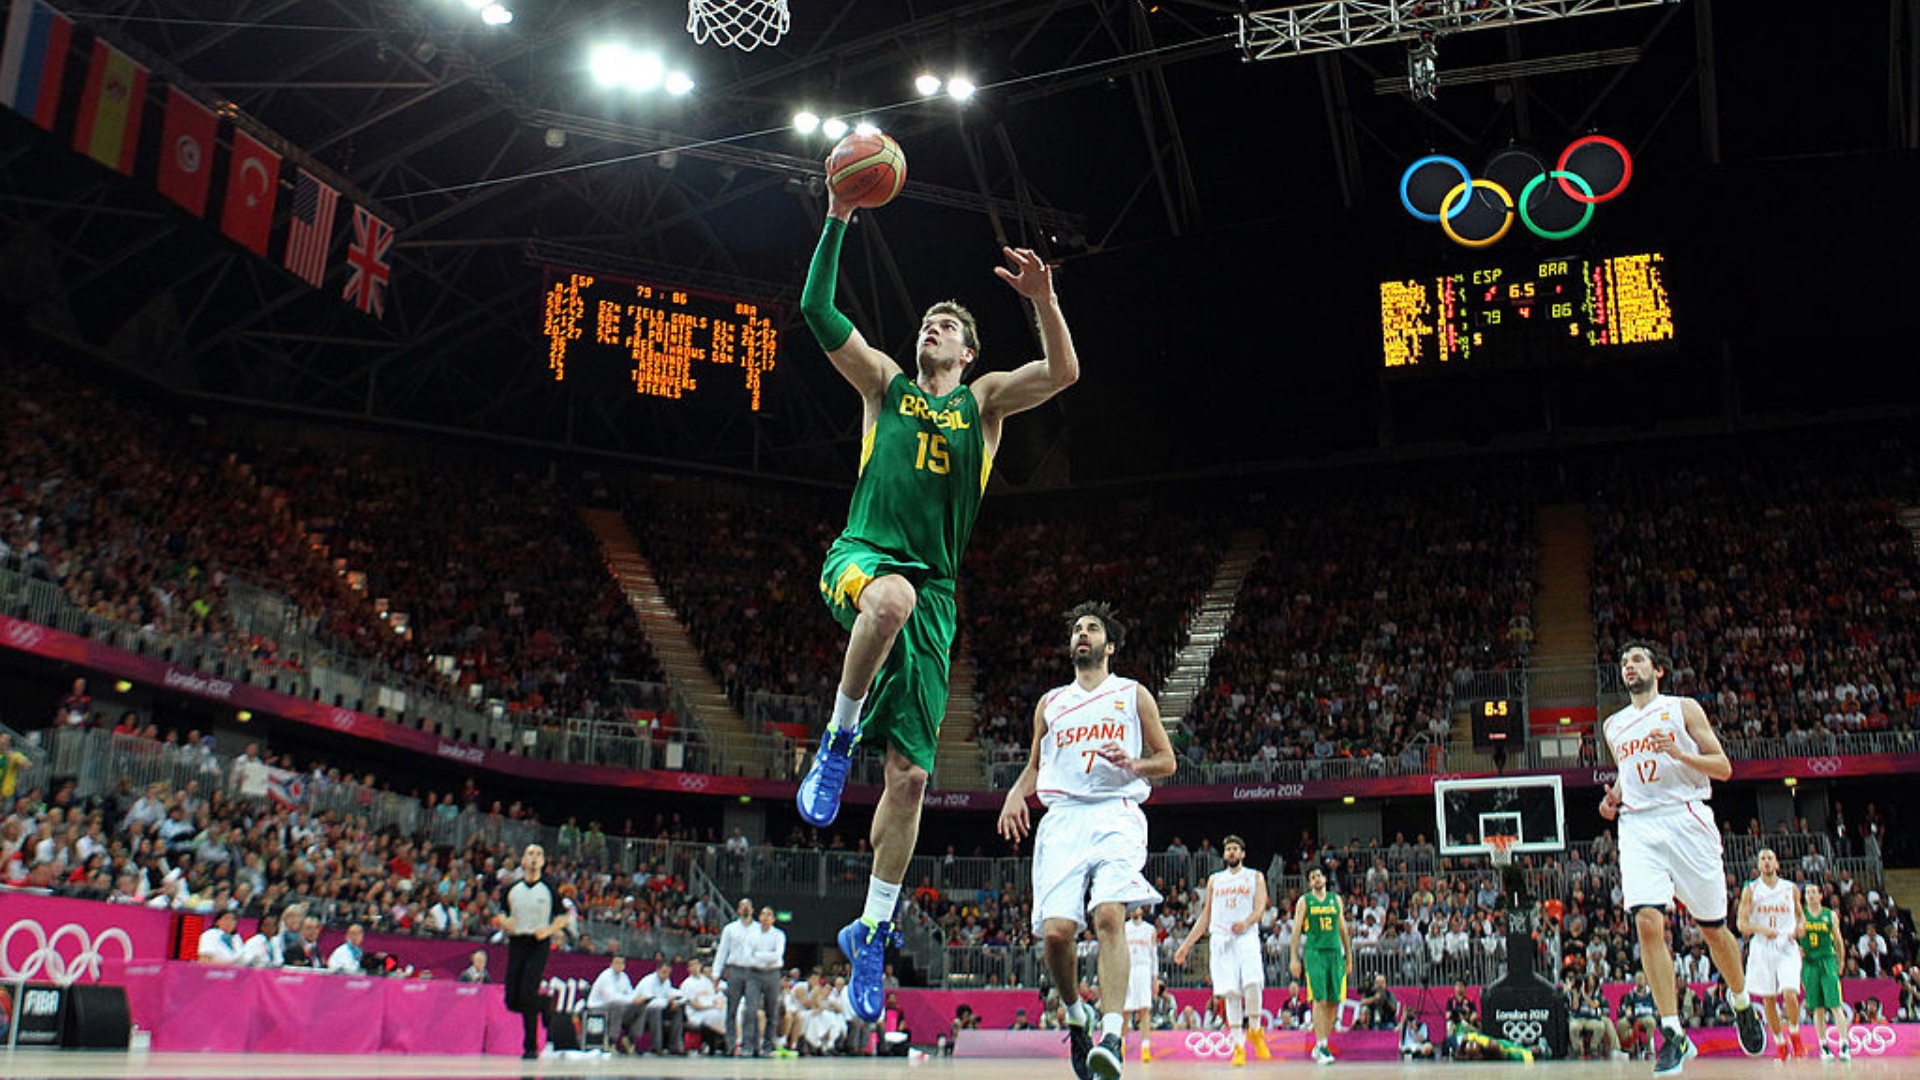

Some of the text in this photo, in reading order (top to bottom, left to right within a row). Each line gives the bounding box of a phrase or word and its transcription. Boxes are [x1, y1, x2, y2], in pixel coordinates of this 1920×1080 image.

[1473, 268, 1502, 285] ESP
[1539, 261, 1568, 277] BRA
[571, 274, 594, 288] ESP
[637, 285, 652, 299] 79
[672, 292, 688, 305] 86
[1509, 282, 1535, 298] 6.5
[627, 305, 708, 329] FIELD GOALS
[735, 302, 757, 316] BRA
[1552, 302, 1572, 318] 86
[1482, 310, 1501, 325] 79
[636, 382, 682, 399] STEALS
[915, 431, 950, 475] 15
[1057, 716, 1126, 748] ESPAÑA
[1081, 749, 1098, 774] 7
[1593, 769, 1618, 783] Lon
[1636, 759, 1660, 785] 12
[1233, 783, 1304, 799] London 2012
[1320, 917, 1333, 931] 12
[1808, 932, 1819, 947] 9
[24, 989, 60, 1016] FIBA
[1495, 1009, 1528, 1021] London
